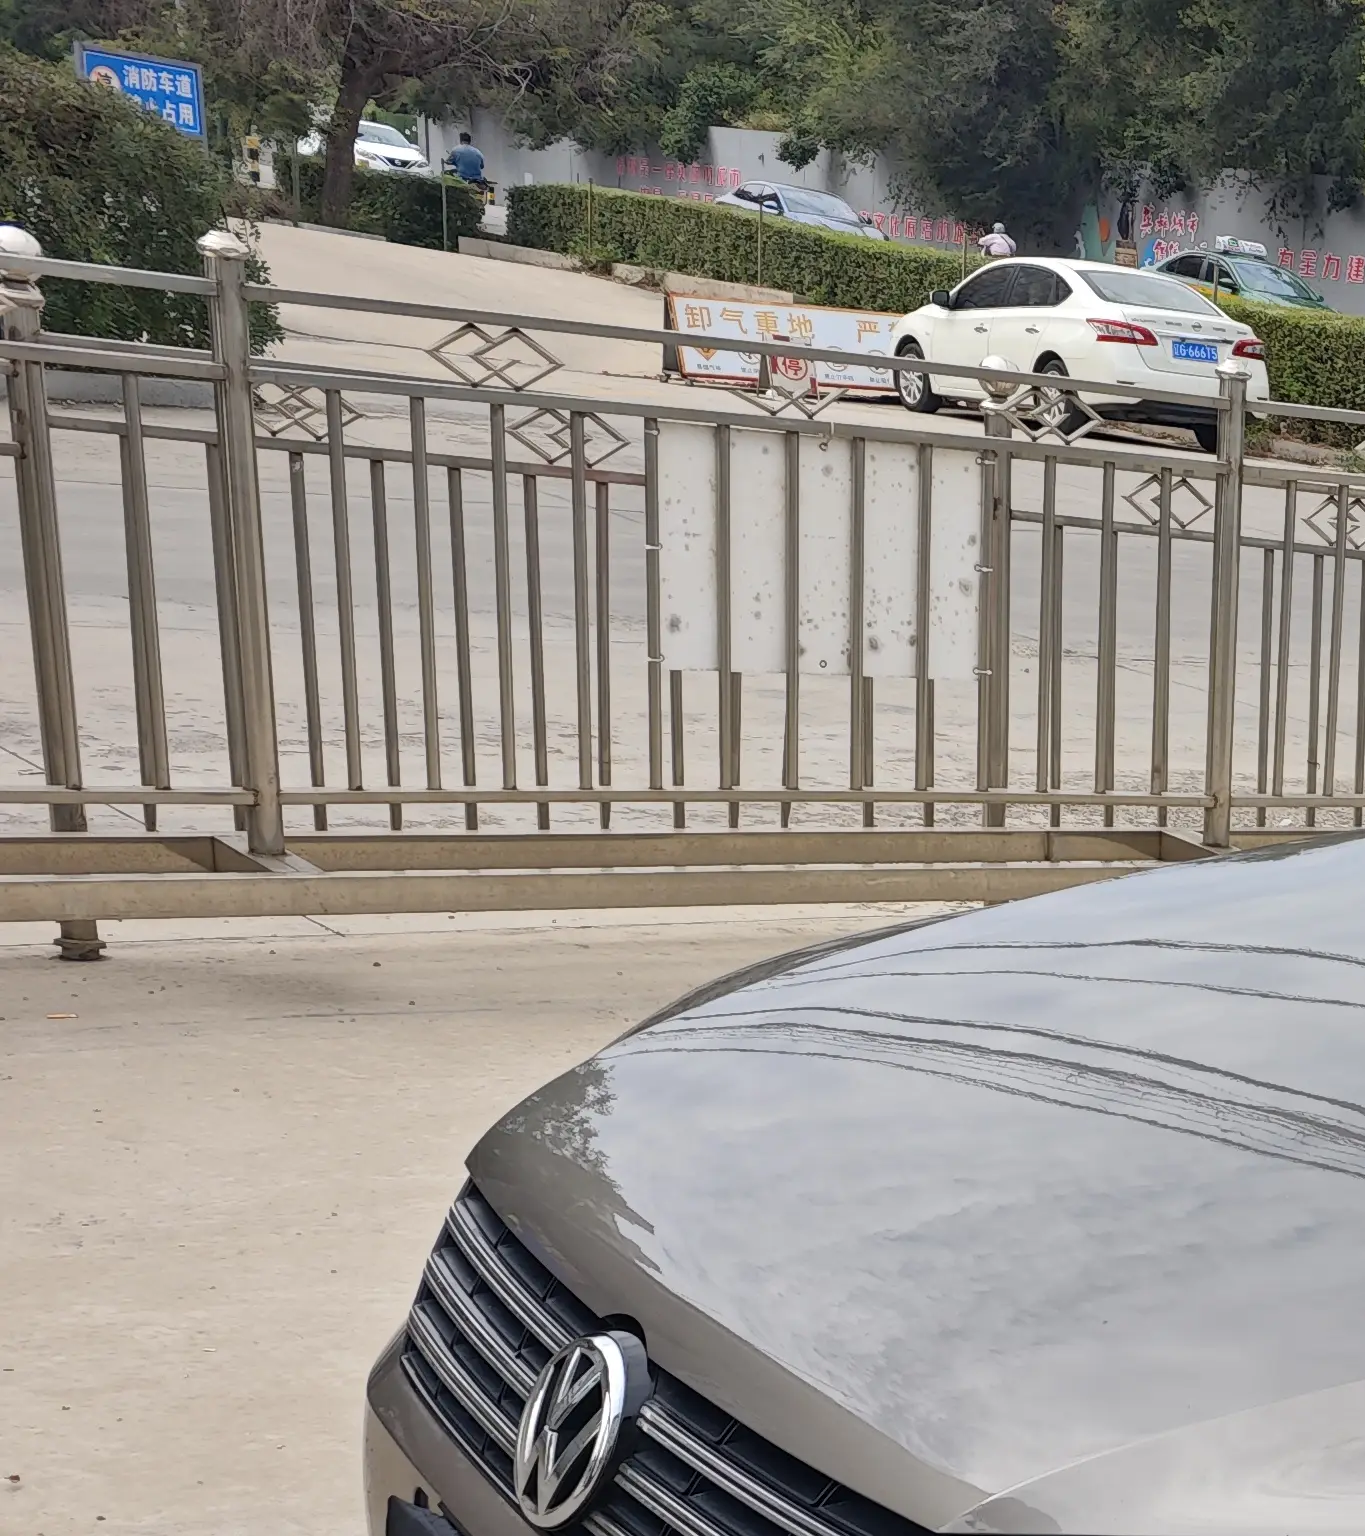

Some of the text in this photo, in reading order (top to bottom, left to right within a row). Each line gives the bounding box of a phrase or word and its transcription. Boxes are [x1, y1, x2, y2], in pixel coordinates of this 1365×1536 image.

[122, 64, 193, 99] 消防车道
[126, 93, 195, 127] 止占用
[684, 304, 813, 338] 卸气重地
[783, 354, 804, 376] 停
